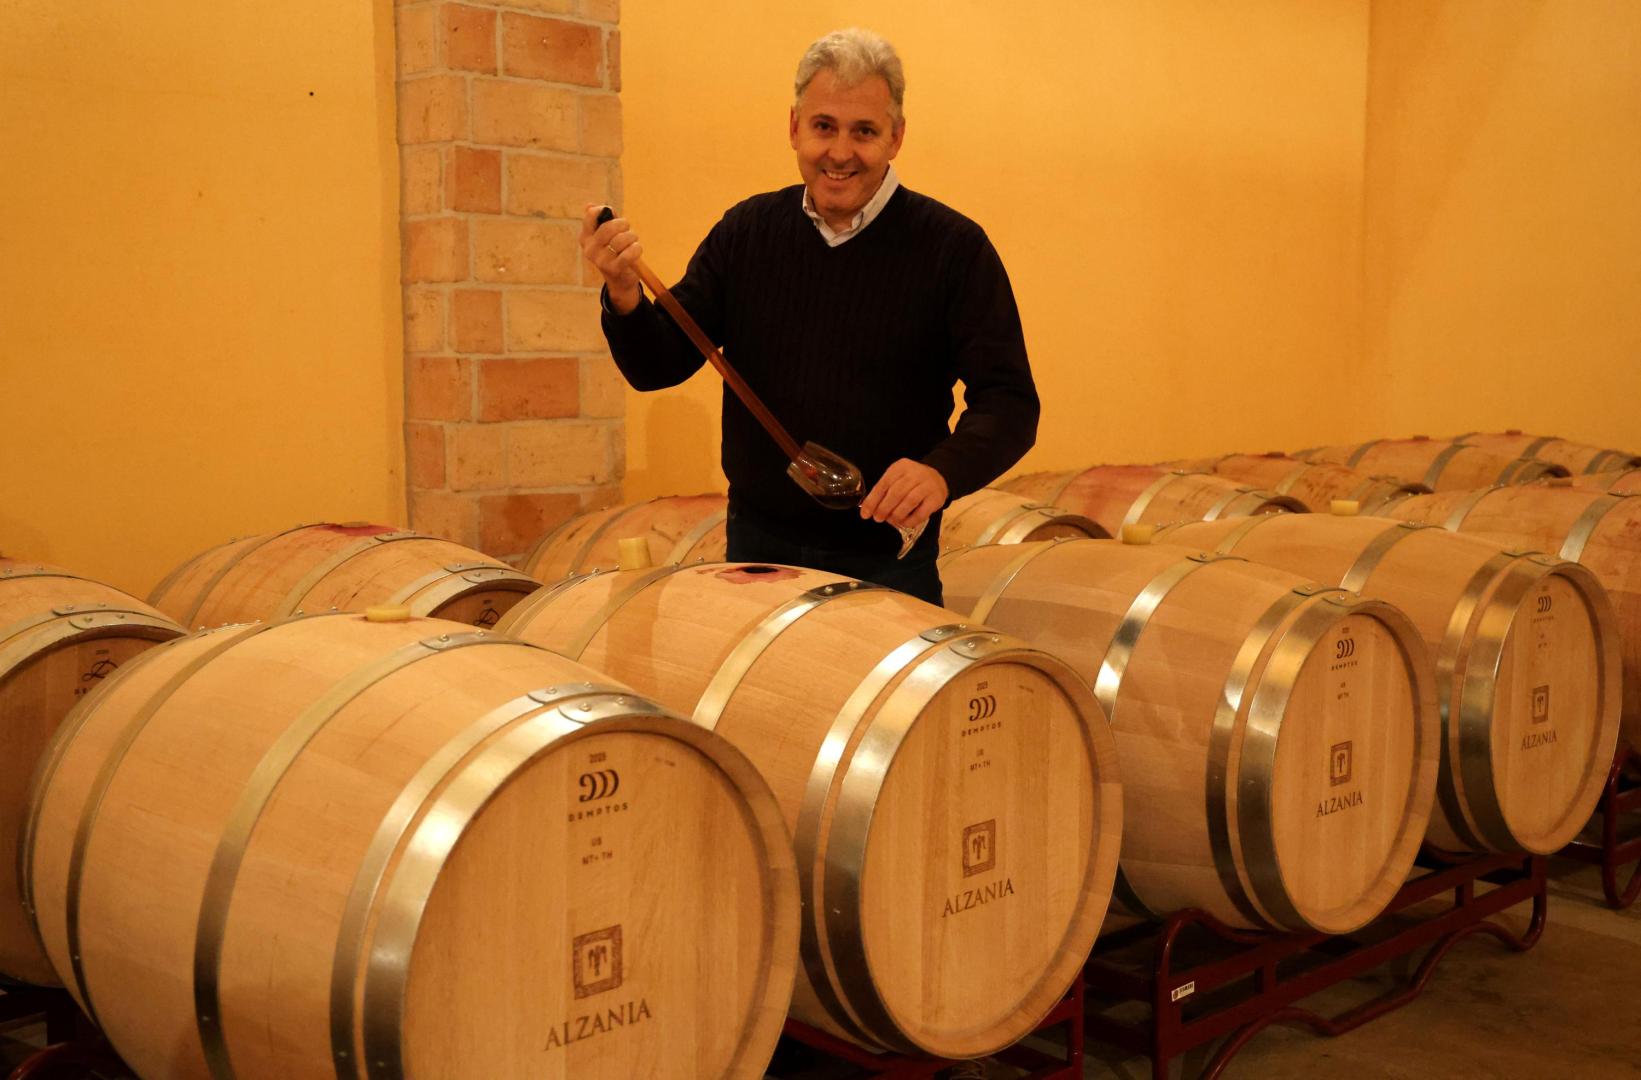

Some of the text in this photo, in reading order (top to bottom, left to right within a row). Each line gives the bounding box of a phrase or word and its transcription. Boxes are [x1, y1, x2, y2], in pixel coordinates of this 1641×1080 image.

[1521, 729, 1557, 751] ALZANIA
[568, 802, 629, 822] DEMPTOS
[1316, 790, 1363, 818] ALZANIA
[942, 878, 1014, 918] ALZANIA
[544, 998, 652, 1051] ALZANIA
